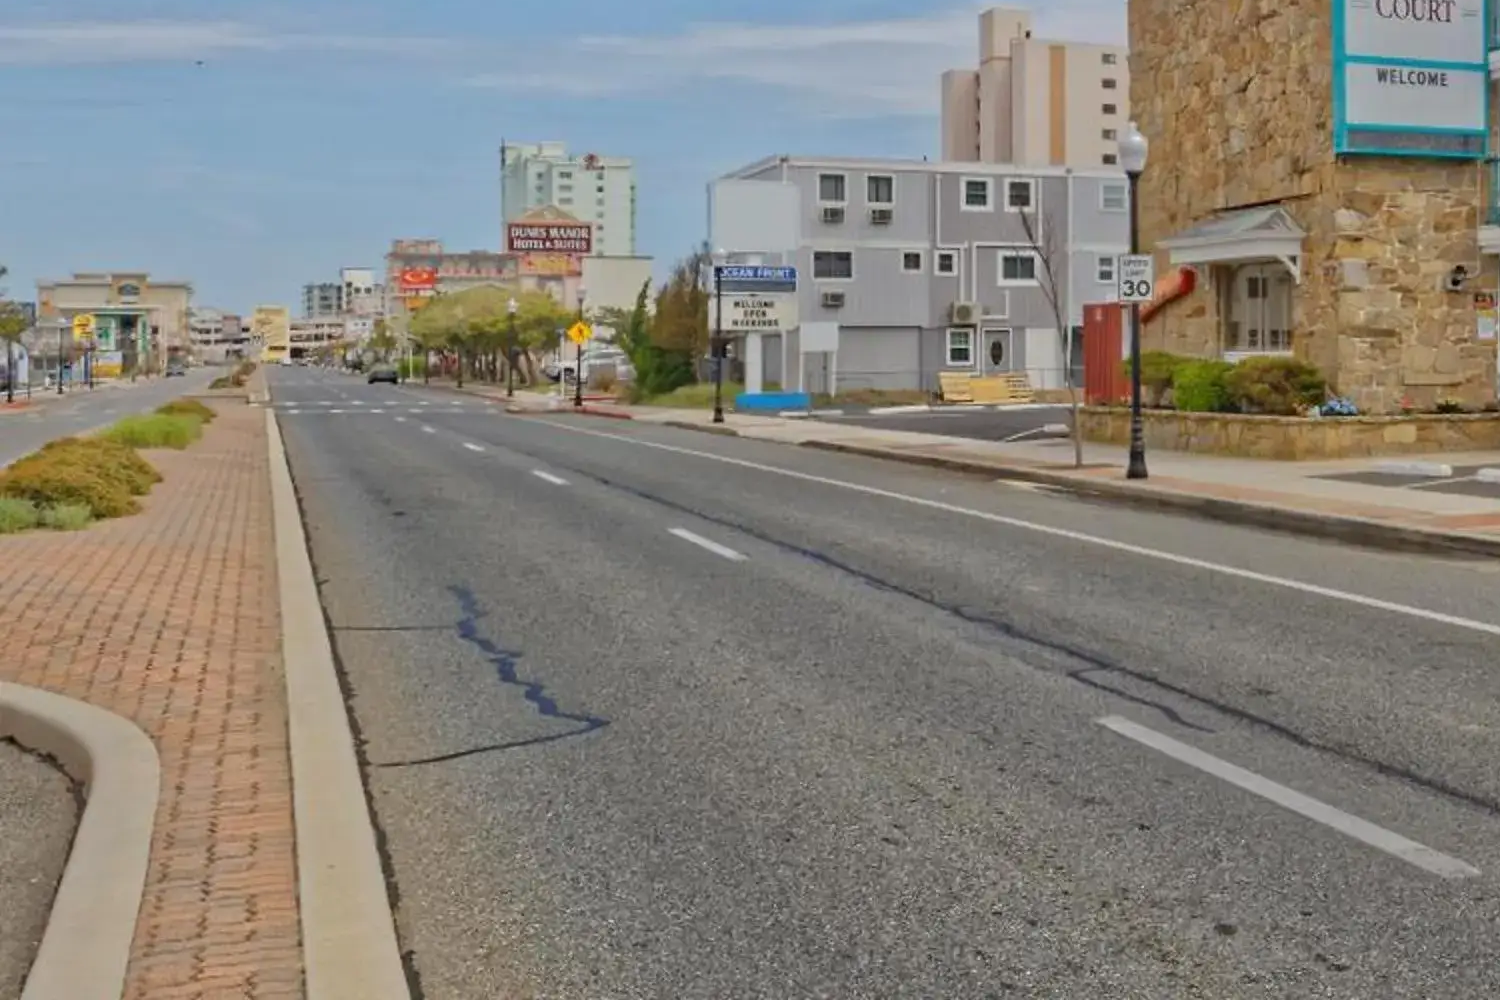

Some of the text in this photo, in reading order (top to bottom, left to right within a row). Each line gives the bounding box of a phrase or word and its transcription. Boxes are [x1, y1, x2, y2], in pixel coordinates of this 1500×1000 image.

[1376, 67, 1449, 87] WELCOME
[511, 226, 589, 239] DUNES MANOR
[513, 238, 544, 249] HOTEL
[1122, 279, 1151, 297] 30
